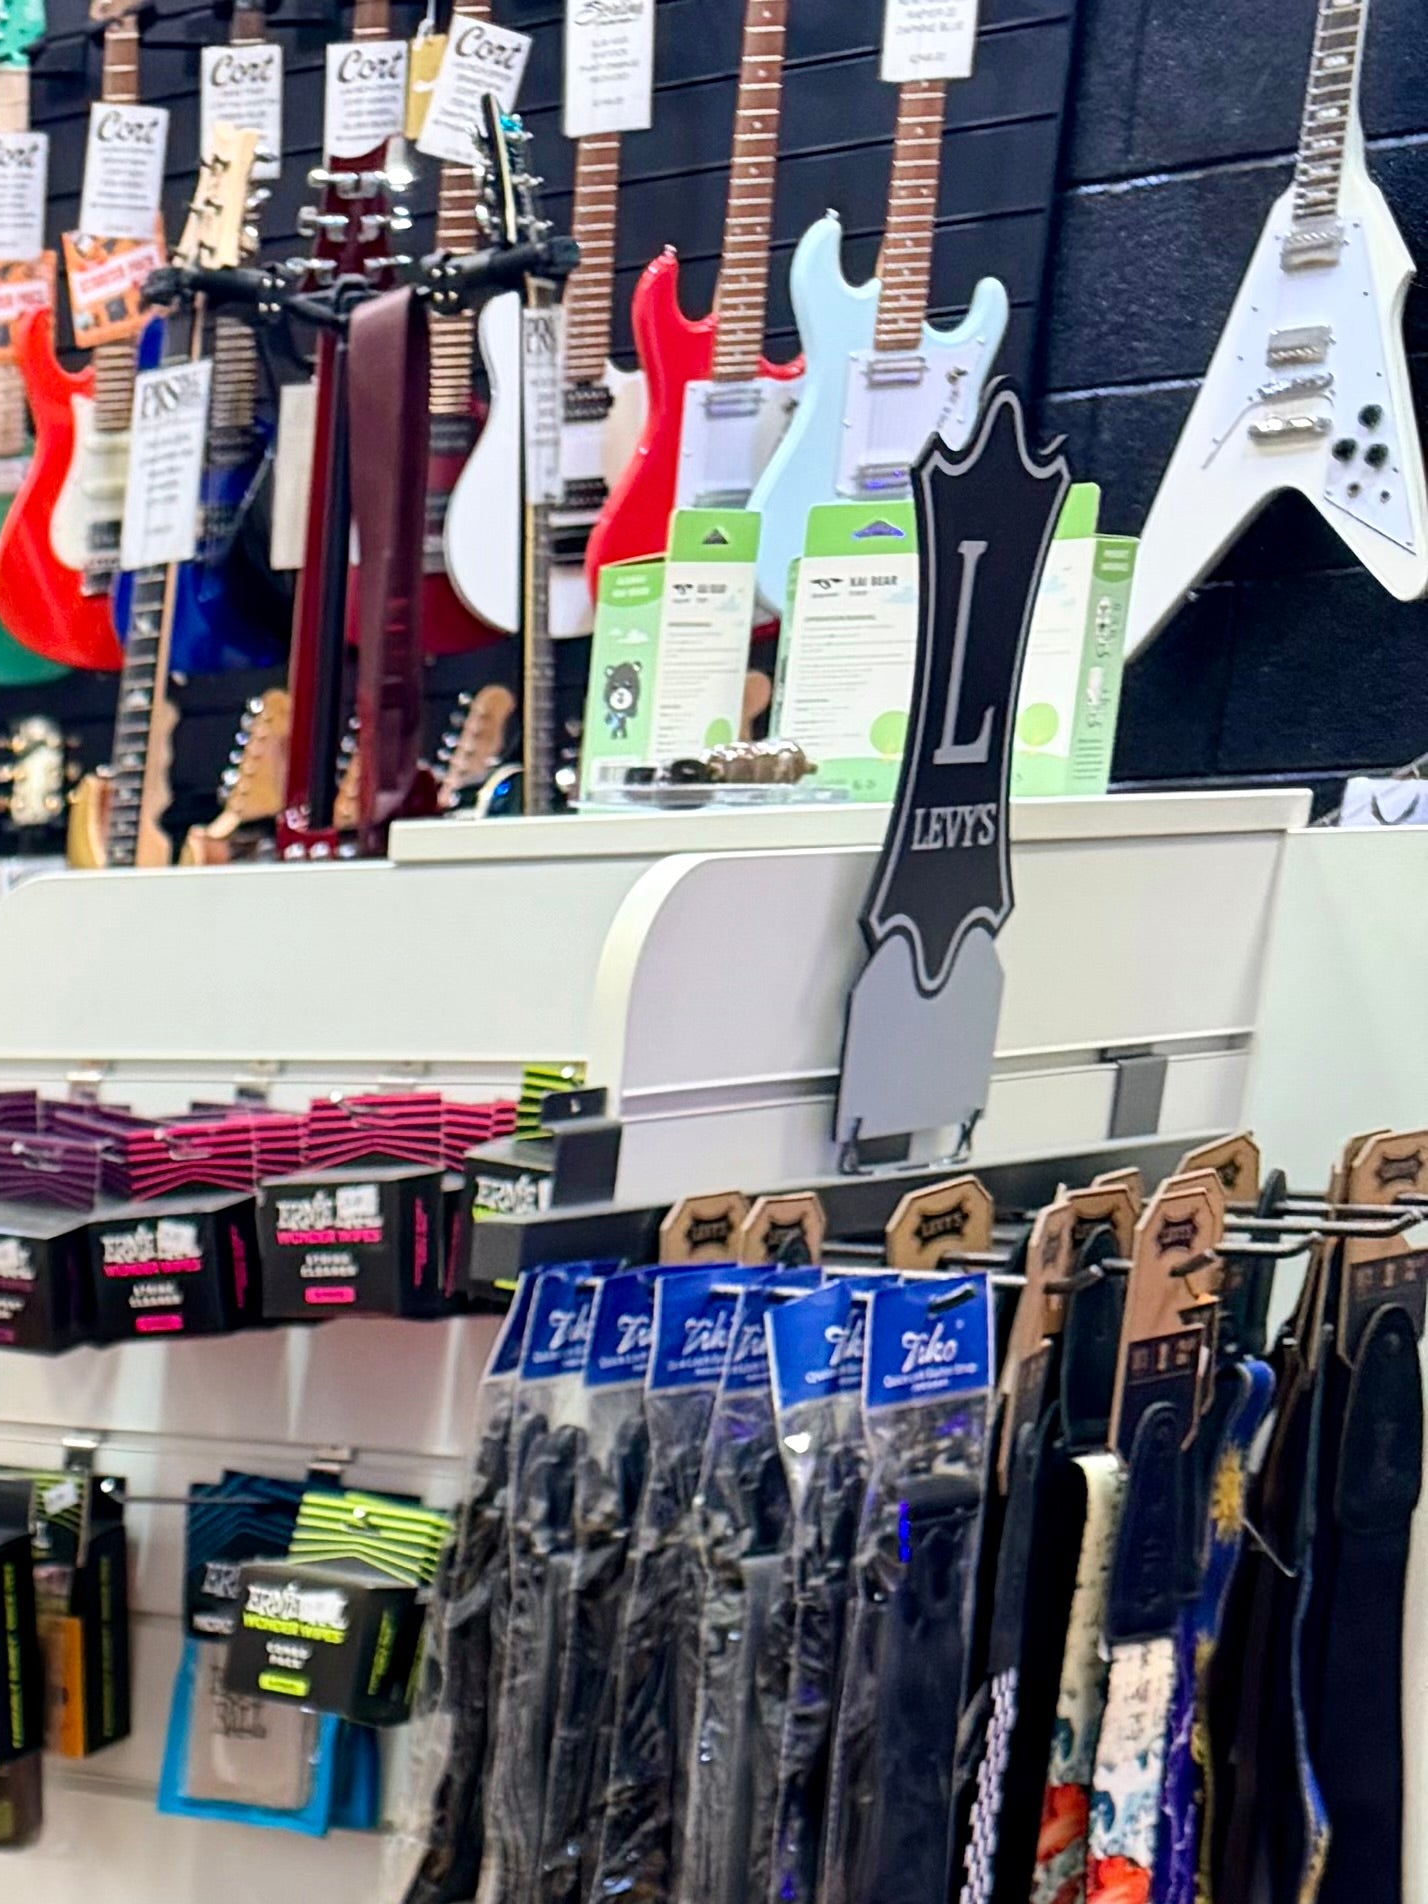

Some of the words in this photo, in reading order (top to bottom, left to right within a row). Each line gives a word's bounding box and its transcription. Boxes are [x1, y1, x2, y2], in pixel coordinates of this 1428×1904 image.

[336, 48, 406, 84] Cort
[454, 25, 523, 72] Cort
[210, 54, 274, 87] Cort
[96, 110, 159, 145] Cort
